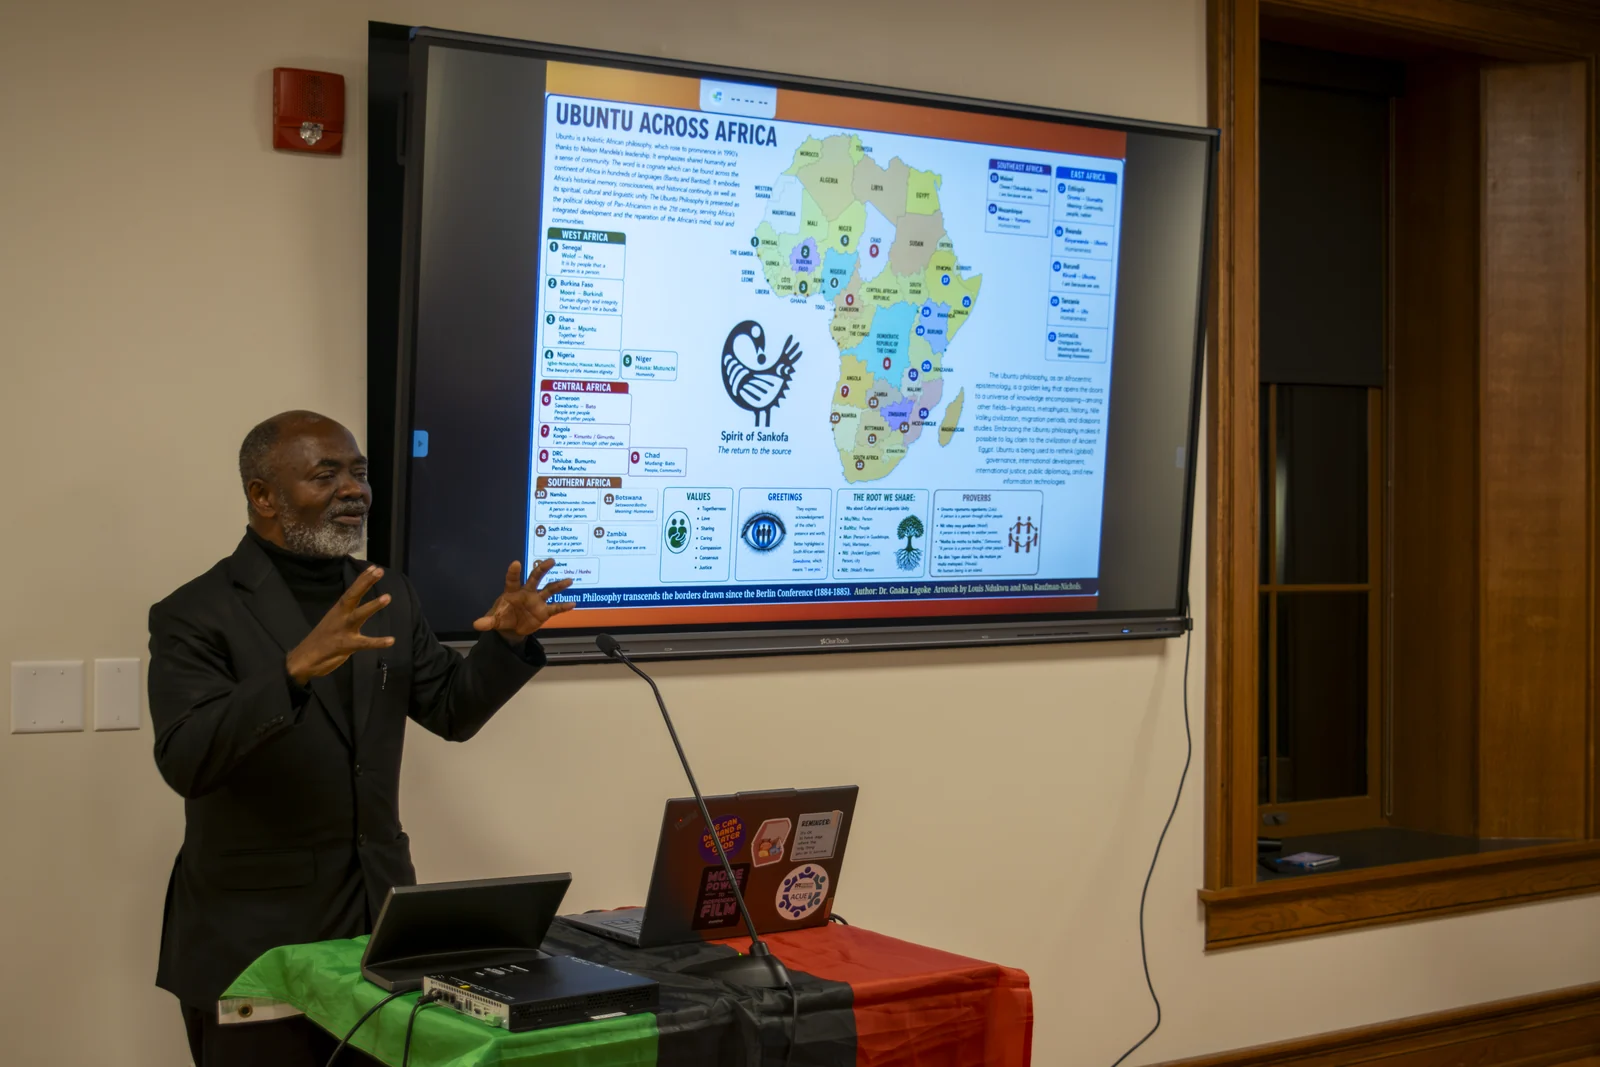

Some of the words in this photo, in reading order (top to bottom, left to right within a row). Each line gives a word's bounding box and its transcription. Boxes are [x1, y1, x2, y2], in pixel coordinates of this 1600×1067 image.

[556, 102, 633, 131] UBUNTU
[639, 112, 709, 140] ACROSS
[715, 120, 777, 147] AFRICA
[997, 161, 1024, 171] SOUTHEAST
[1025, 165, 1043, 173] AFRICA
[1071, 171, 1085, 179] EAST
[1086, 172, 1106, 181] AFRICA
[562, 230, 581, 241] WEST
[583, 232, 608, 242] AFRICA
[562, 244, 582, 252] Senegal
[830, 268, 846, 276] NIGERIA
[553, 382, 584, 391] CENTRAL
[586, 383, 611, 392] AFRICA
[721, 430, 743, 443] Spirit
[746, 432, 754, 441] of
[757, 432, 788, 442] Sankofa
[718, 446, 729, 454] The
[548, 478, 584, 487] SOUTHERN
[586, 479, 611, 487] AFRICA
[687, 493, 711, 501] VALUES
[768, 493, 802, 501] GREETINGS
[894, 494, 916, 502] SHARE:
[963, 494, 991, 502] PROVERBS
[554, 593, 581, 603] Ubuntu
[583, 593, 622, 603] Philosophy
[623, 591, 661, 601] transcends
[662, 591, 673, 600] the
[674, 591, 701, 600] borders
[702, 590, 724, 599] drawn
[726, 589, 743, 598] since
[744, 589, 755, 598] the
[756, 588, 776, 598] Berlin
[777, 588, 813, 597] Conference
[815, 587, 851, 597] (1884-1885).
[854, 587, 878, 595] Author:
[879, 587, 888, 595] Dr.
[890, 586, 908, 594] Gnaka
[910, 585, 931, 595] Lagoke
[934, 585, 958, 593] Artwork
[960, 585, 967, 594] by
[968, 584, 984, 592] Louis
[1010, 583, 1021, 591] and
[722, 818, 737, 829] CAN
[712, 841, 734, 853] GOD
[700, 902, 736, 918] FILM
